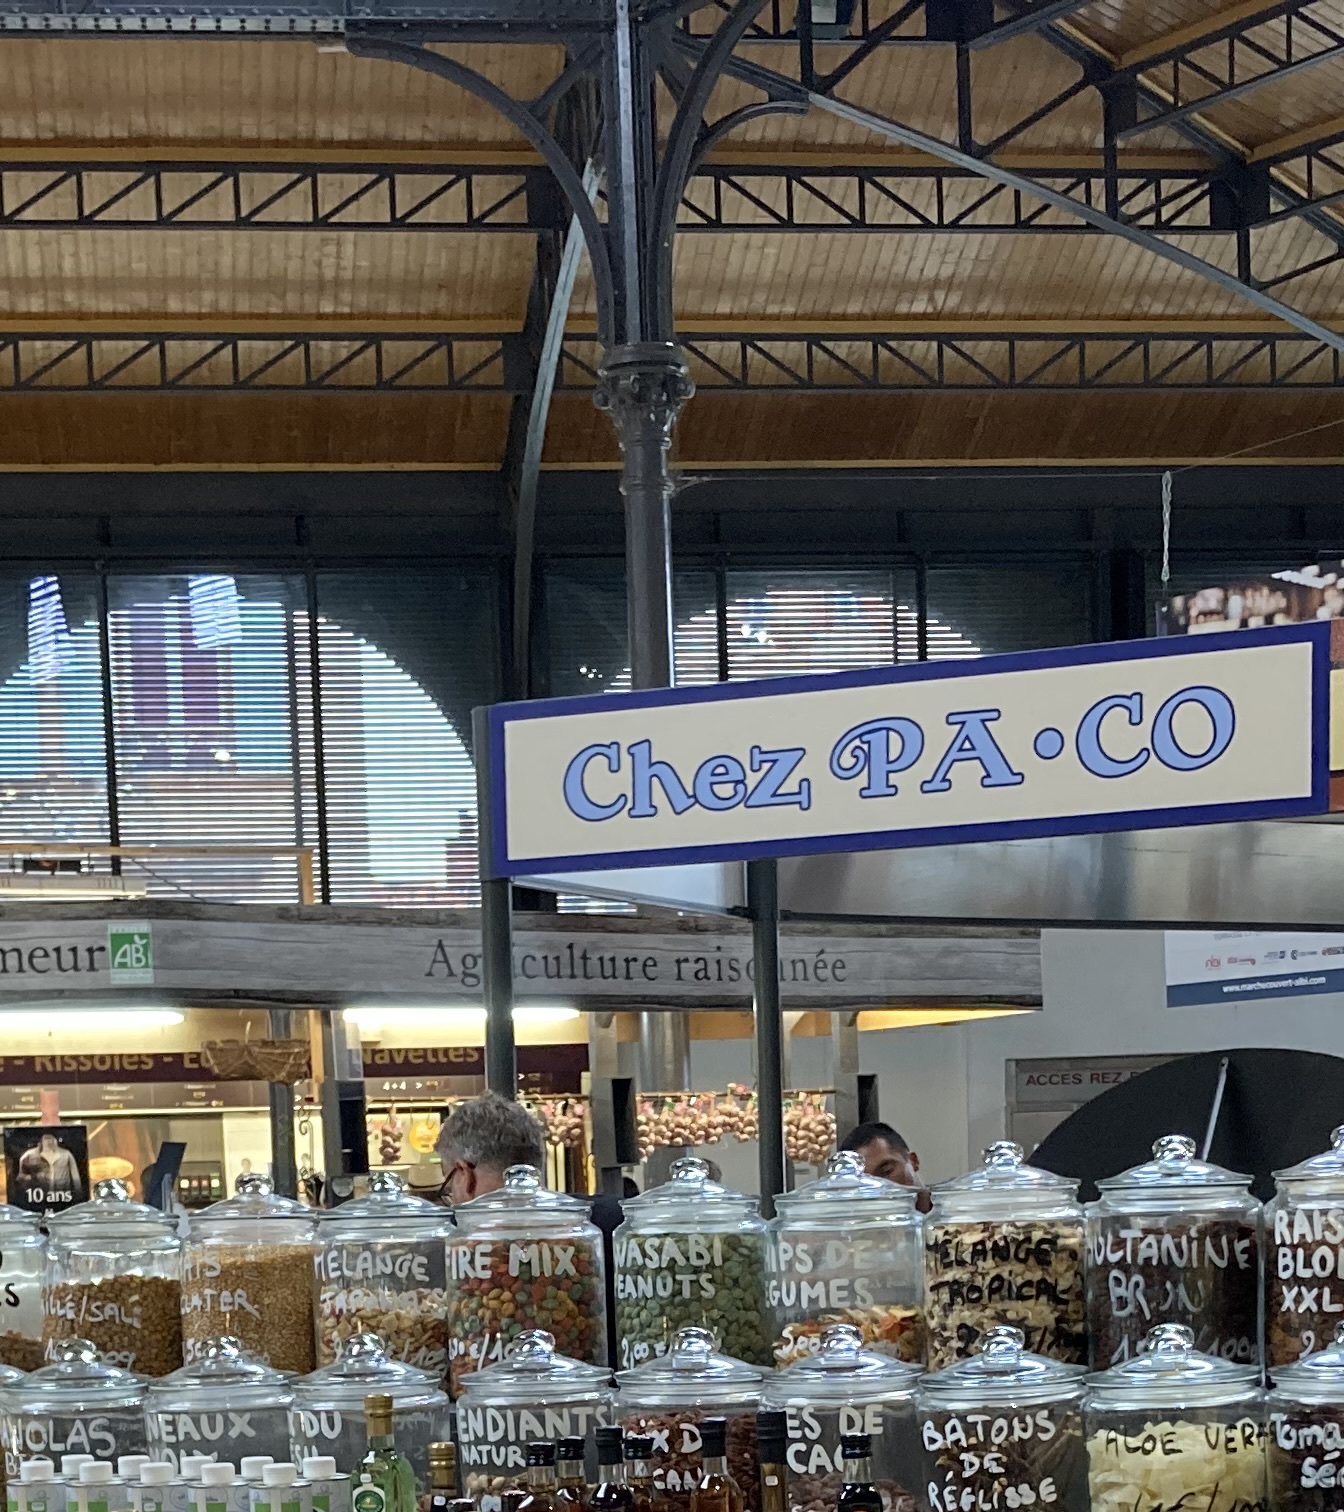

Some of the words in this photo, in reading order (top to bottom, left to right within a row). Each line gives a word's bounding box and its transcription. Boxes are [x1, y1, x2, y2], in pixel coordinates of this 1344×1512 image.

[563, 739, 811, 822] Chez
[425, 939, 657, 988] Agculture
[1025, 1073, 1082, 1086] ACCES
[1090, 1072, 1122, 1084] REZ
[25, 1188, 42, 1203] 10
[46, 1189, 72, 1203] ans
[509, 1243, 576, 1277] MIX
[825, 1239, 875, 1272] DE
[1282, 1285, 1343, 1313] XXL
[1105, 1429, 1183, 1455] ALOE
[959, 1452, 1005, 1478] DE
